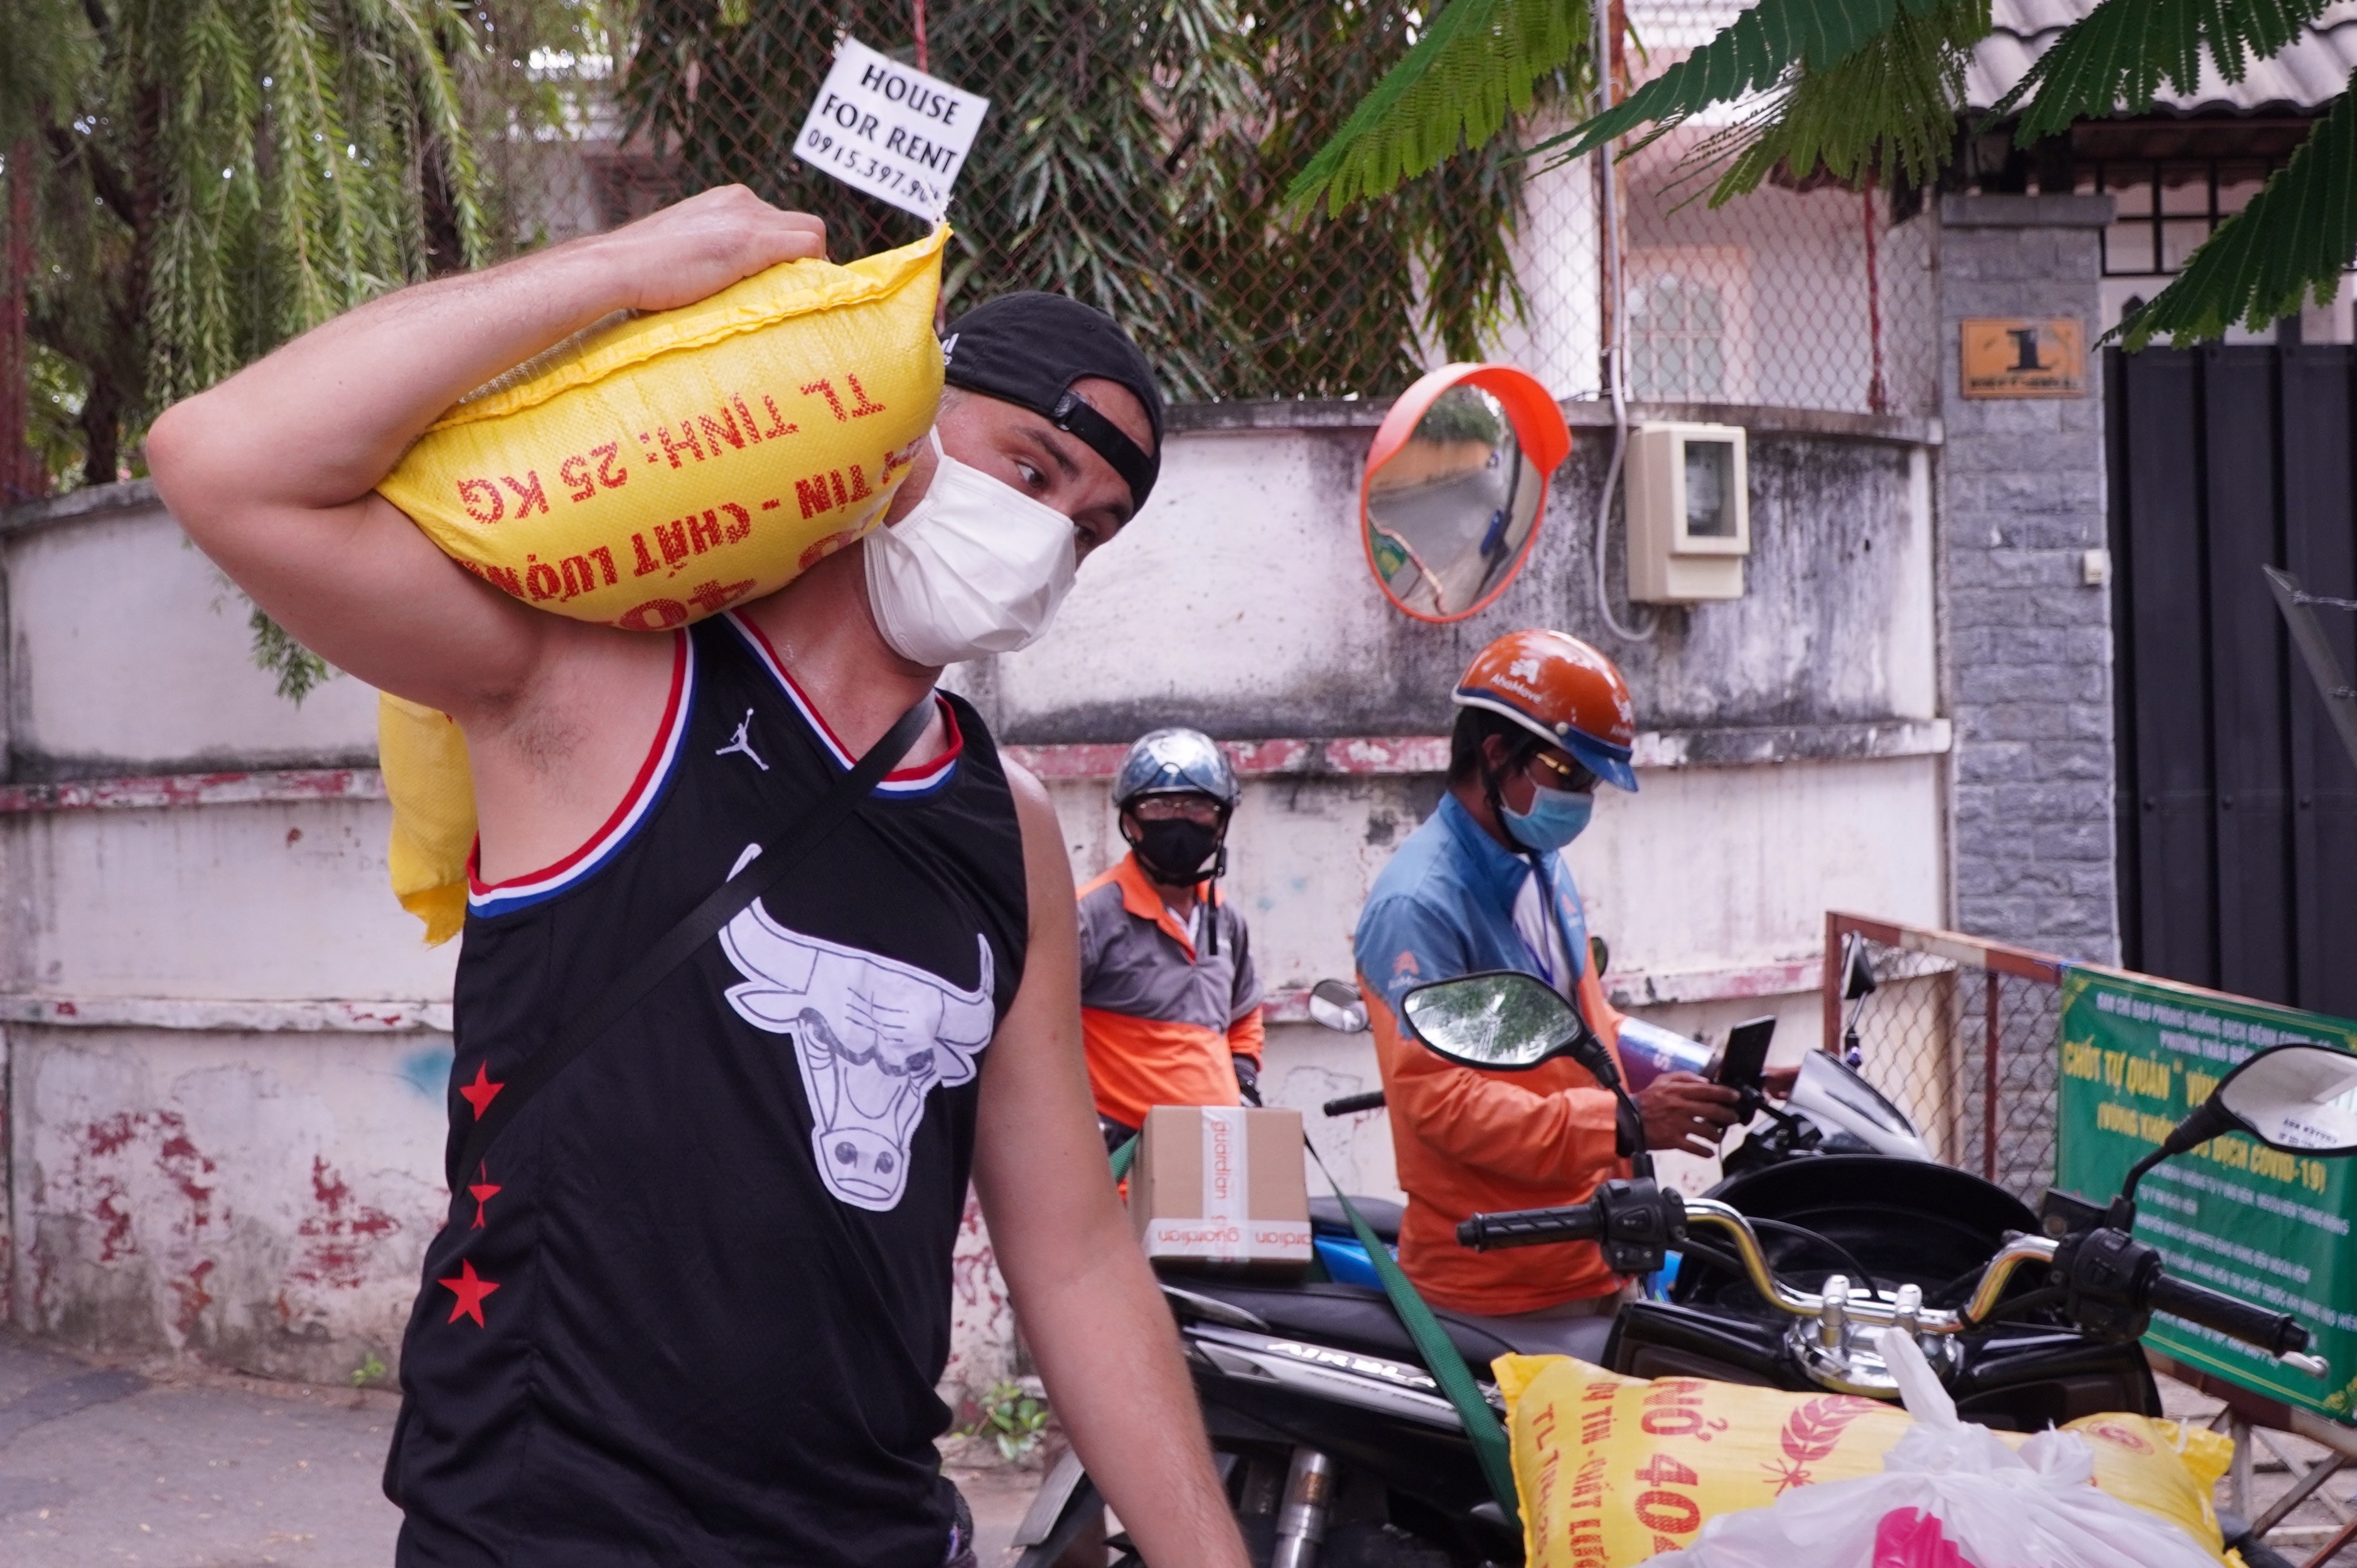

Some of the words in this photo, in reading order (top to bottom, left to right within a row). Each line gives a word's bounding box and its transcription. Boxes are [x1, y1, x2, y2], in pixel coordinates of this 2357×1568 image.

[861, 64, 959, 126] HOUSE
[822, 94, 878, 141] FOR
[886, 127, 958, 174] RENT
[802, 373, 886, 422] TL
[457, 470, 550, 525] KG
[559, 441, 628, 503] 25
[633, 502, 751, 577] CHẤT
[453, 545, 618, 603] LƯỢN
[593, 577, 758, 631] 40
[1532, 1402, 1555, 1451] TL
